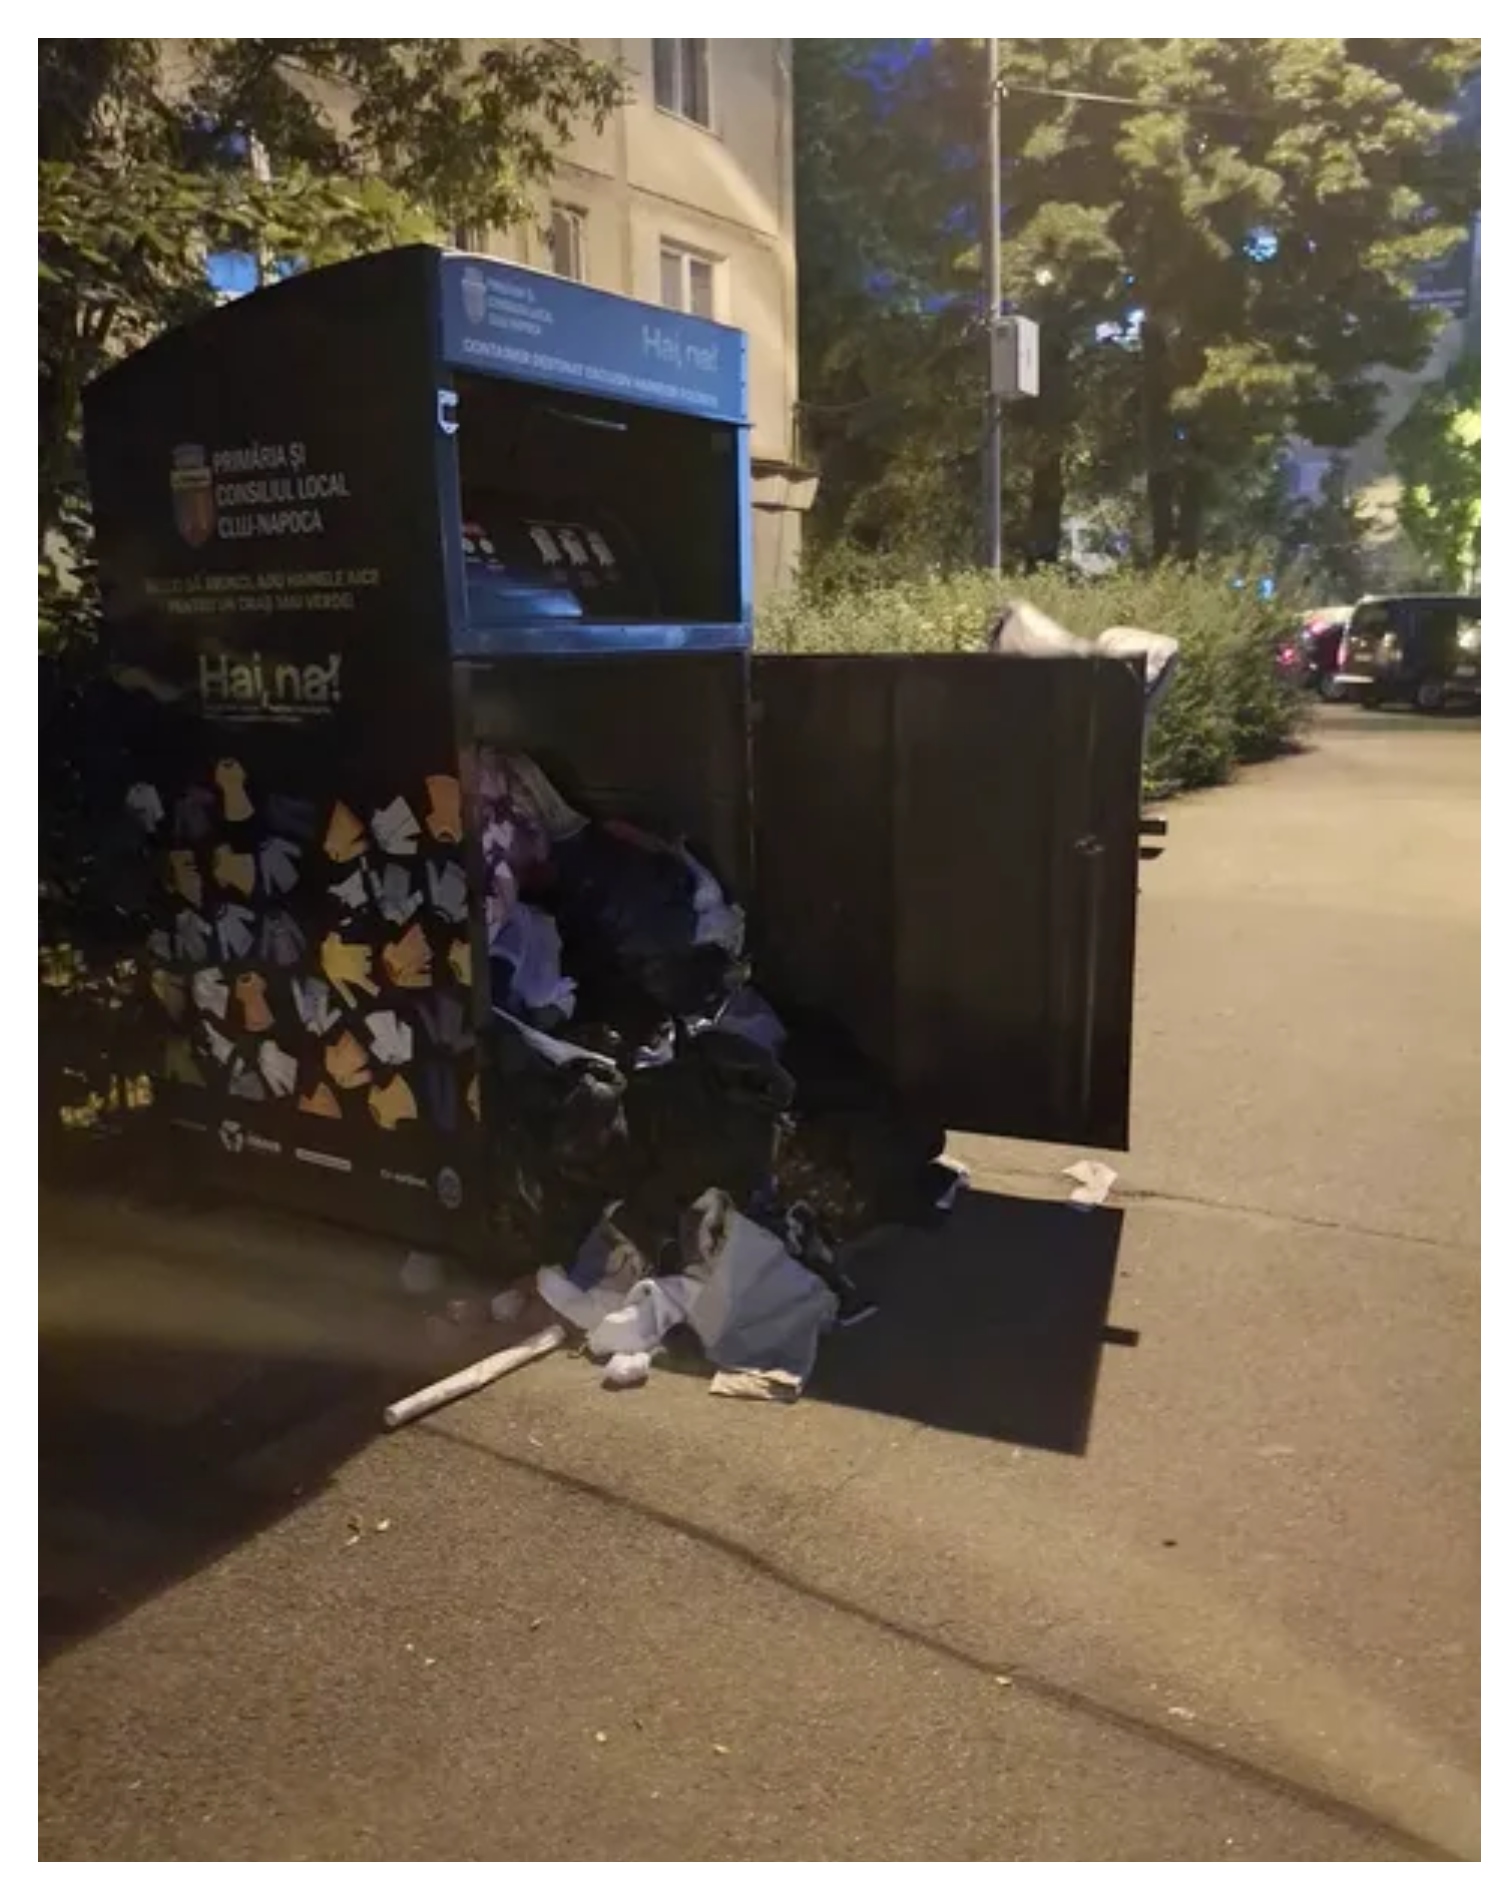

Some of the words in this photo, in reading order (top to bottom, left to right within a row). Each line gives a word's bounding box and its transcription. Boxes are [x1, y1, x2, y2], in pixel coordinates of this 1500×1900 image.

[212, 442, 287, 472] PRIMĂRIA
[217, 478, 294, 506] CONSILIUL
[297, 472, 351, 500] LOCAL
[218, 510, 324, 539] CLUJ-NAPOCA
